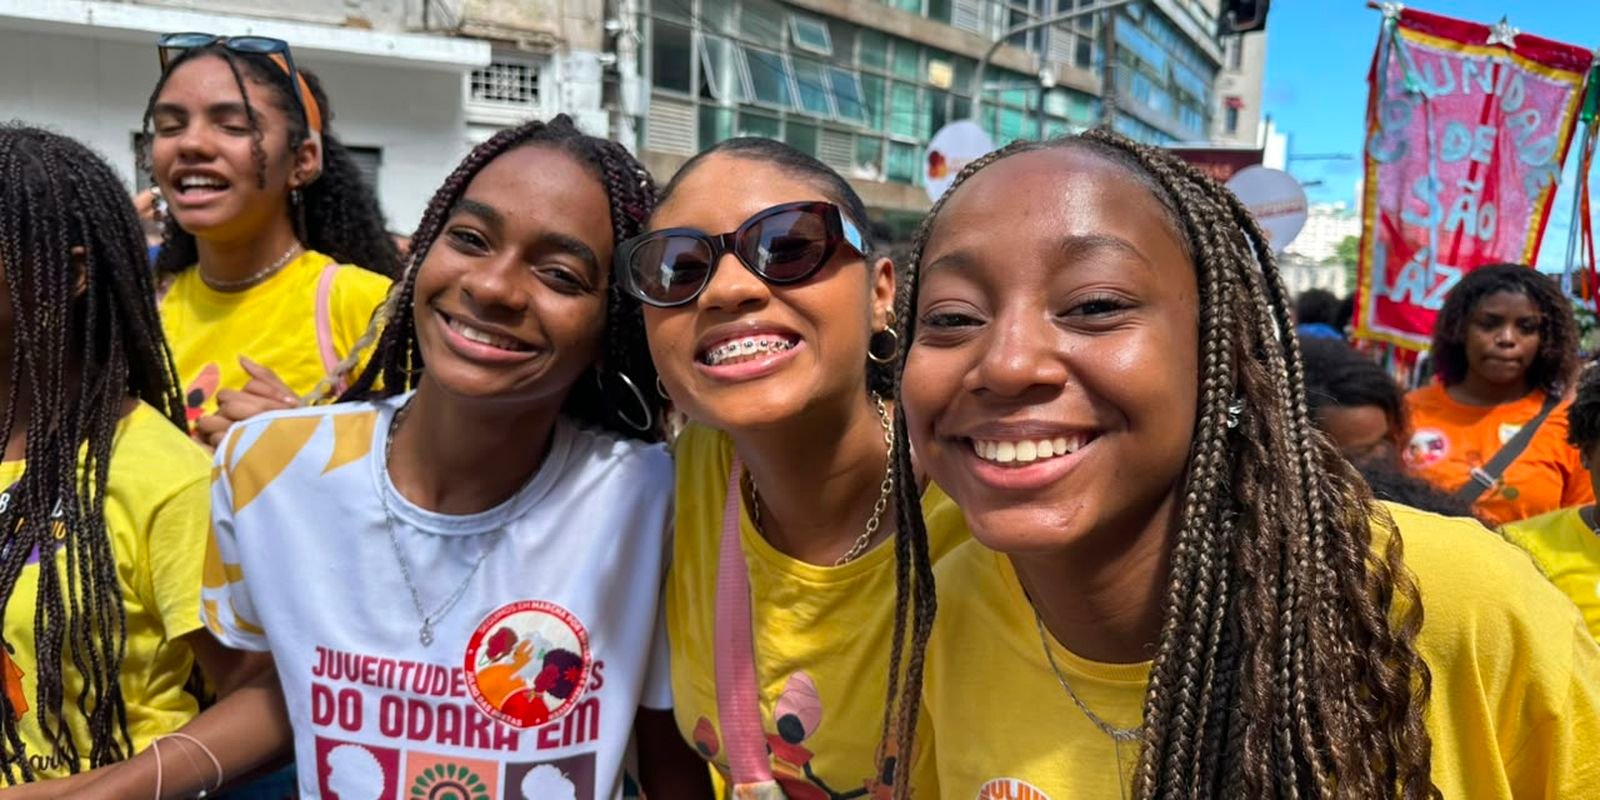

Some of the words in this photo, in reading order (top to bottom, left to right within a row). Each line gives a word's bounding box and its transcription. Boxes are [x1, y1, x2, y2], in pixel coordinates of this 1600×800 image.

[1368, 55, 1562, 200] COUNIDADE
[1441, 121, 1497, 165] DE
[1401, 175, 1497, 241] SÃO
[1372, 240, 1463, 310] LÁZ
[531, 600, 568, 619] MARCHA
[311, 682, 363, 732] DO
